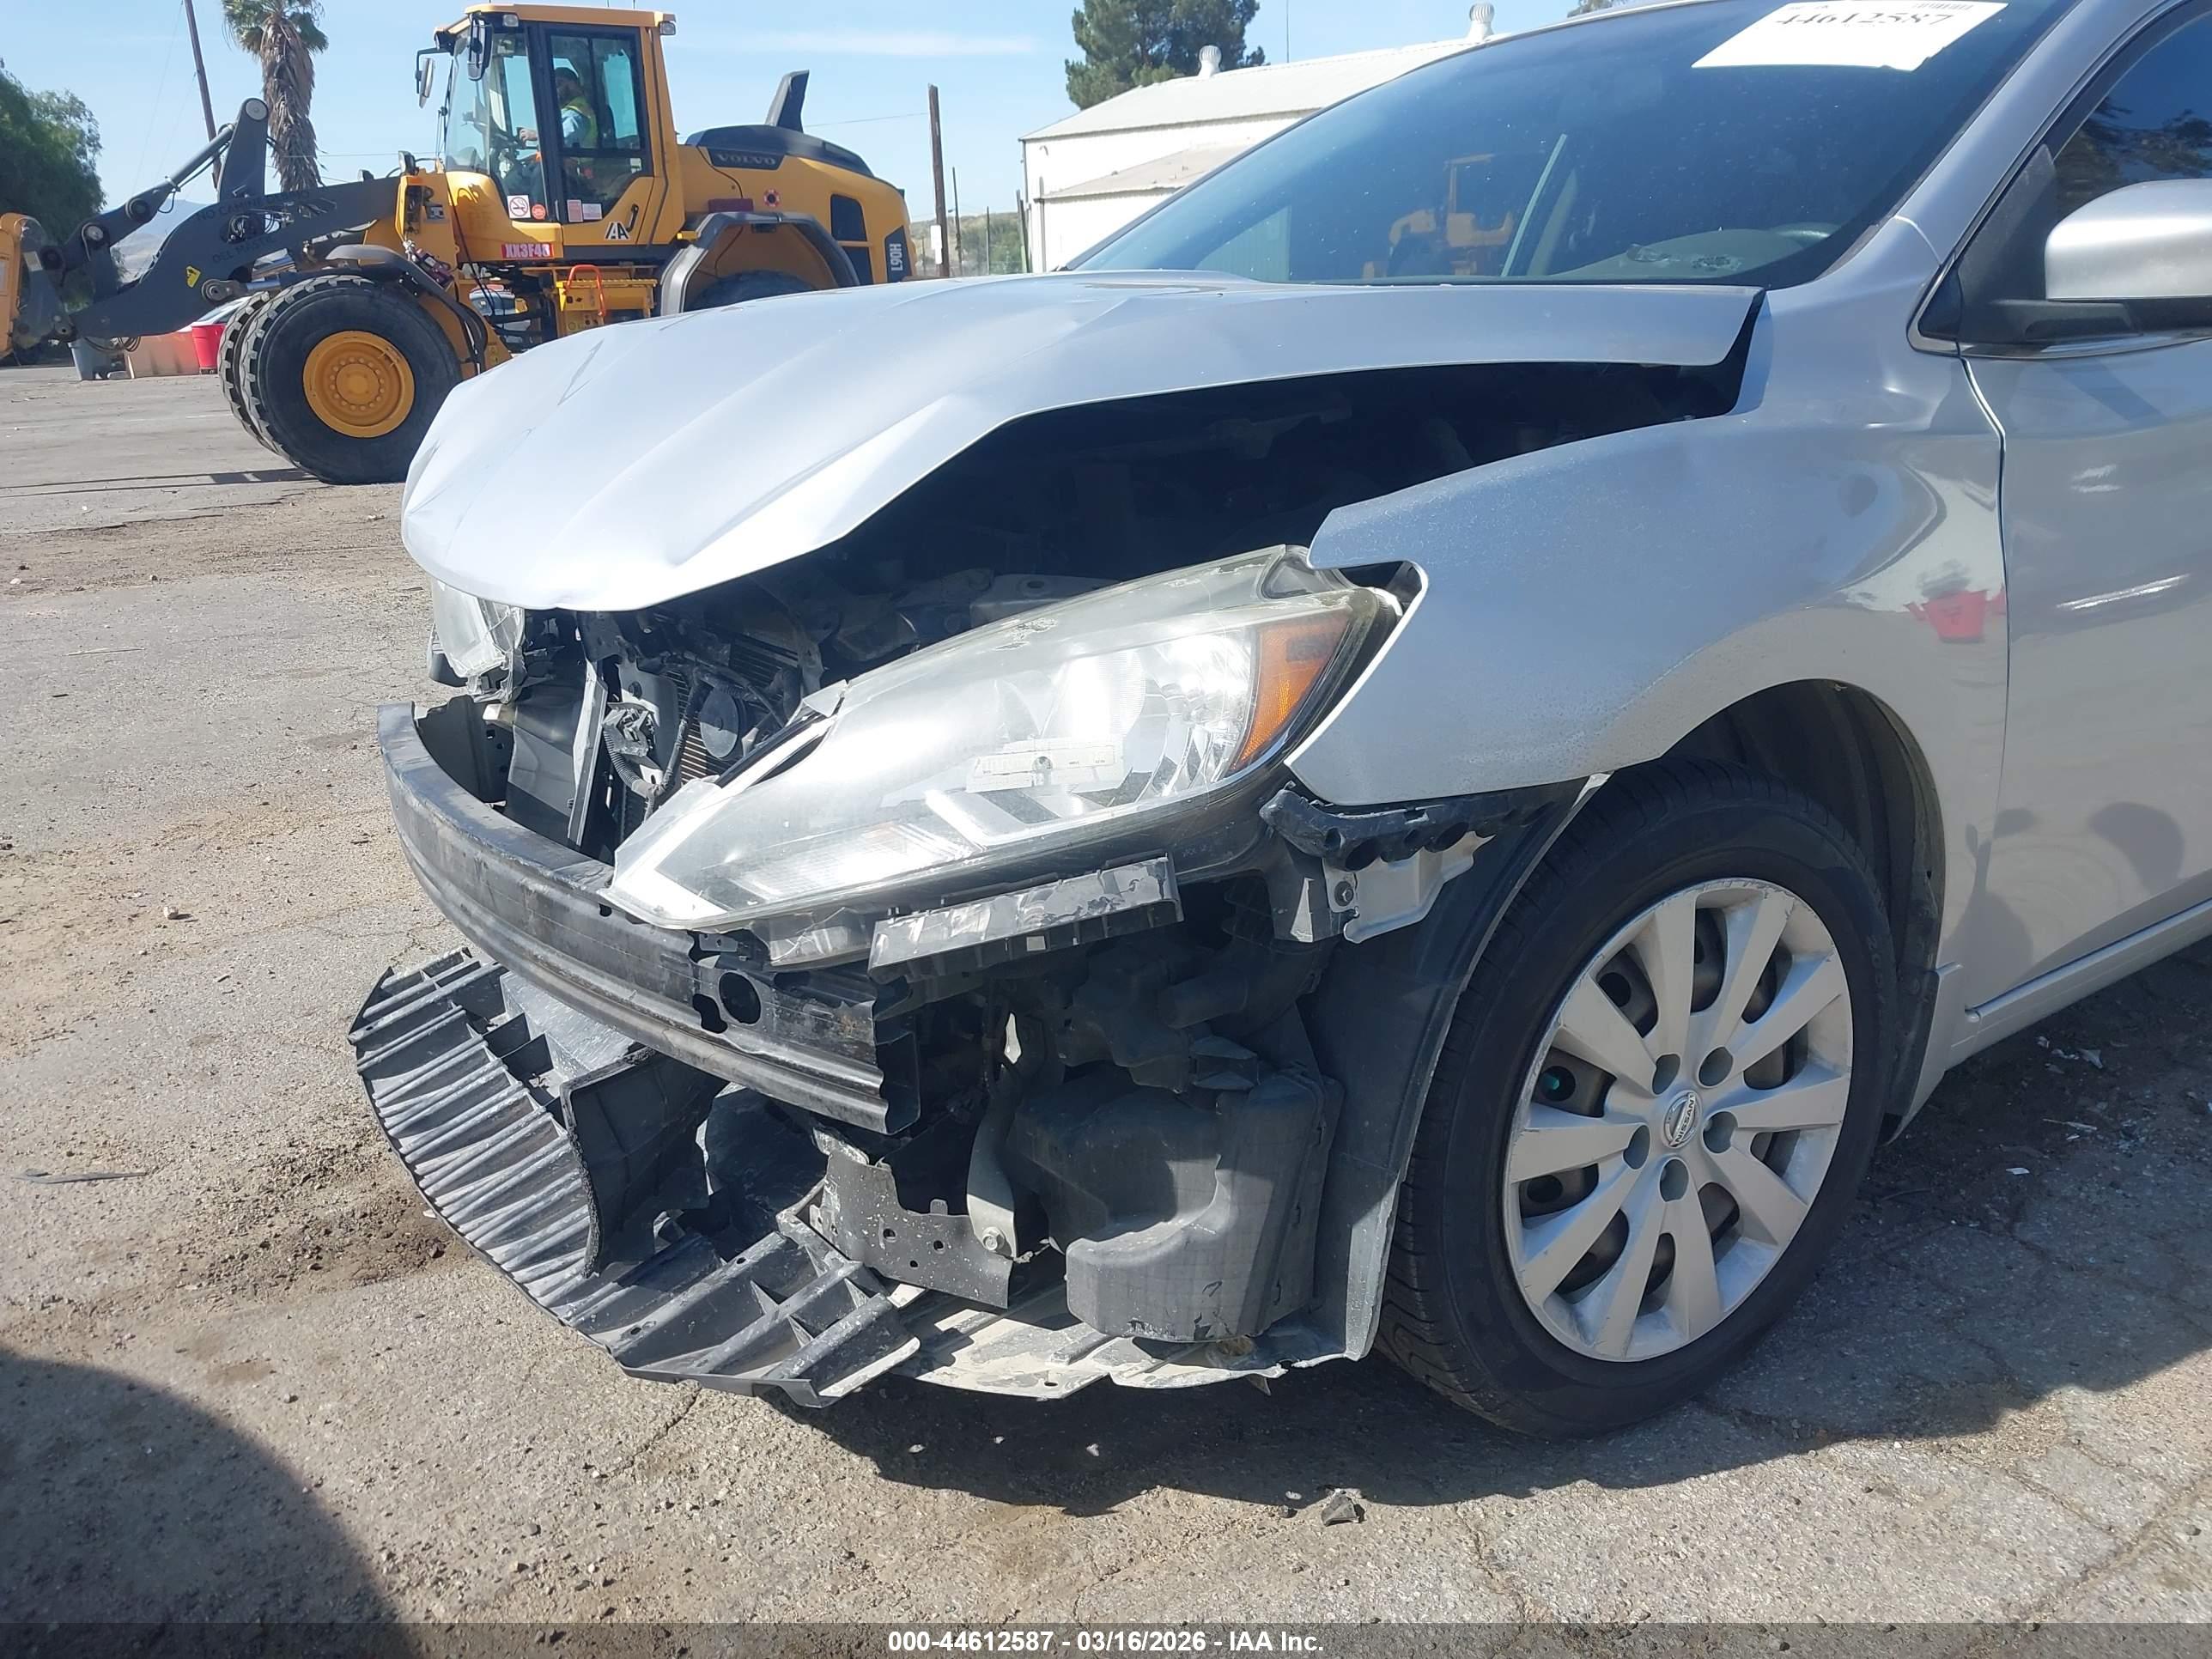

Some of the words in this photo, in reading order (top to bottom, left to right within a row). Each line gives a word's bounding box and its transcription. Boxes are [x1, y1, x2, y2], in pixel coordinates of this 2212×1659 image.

[1775, 12, 1955, 25] 44612587
[717, 154, 776, 166] VOLVO
[889, 243, 903, 271] L90H
[1674, 1099, 1695, 1142] NISSAN
